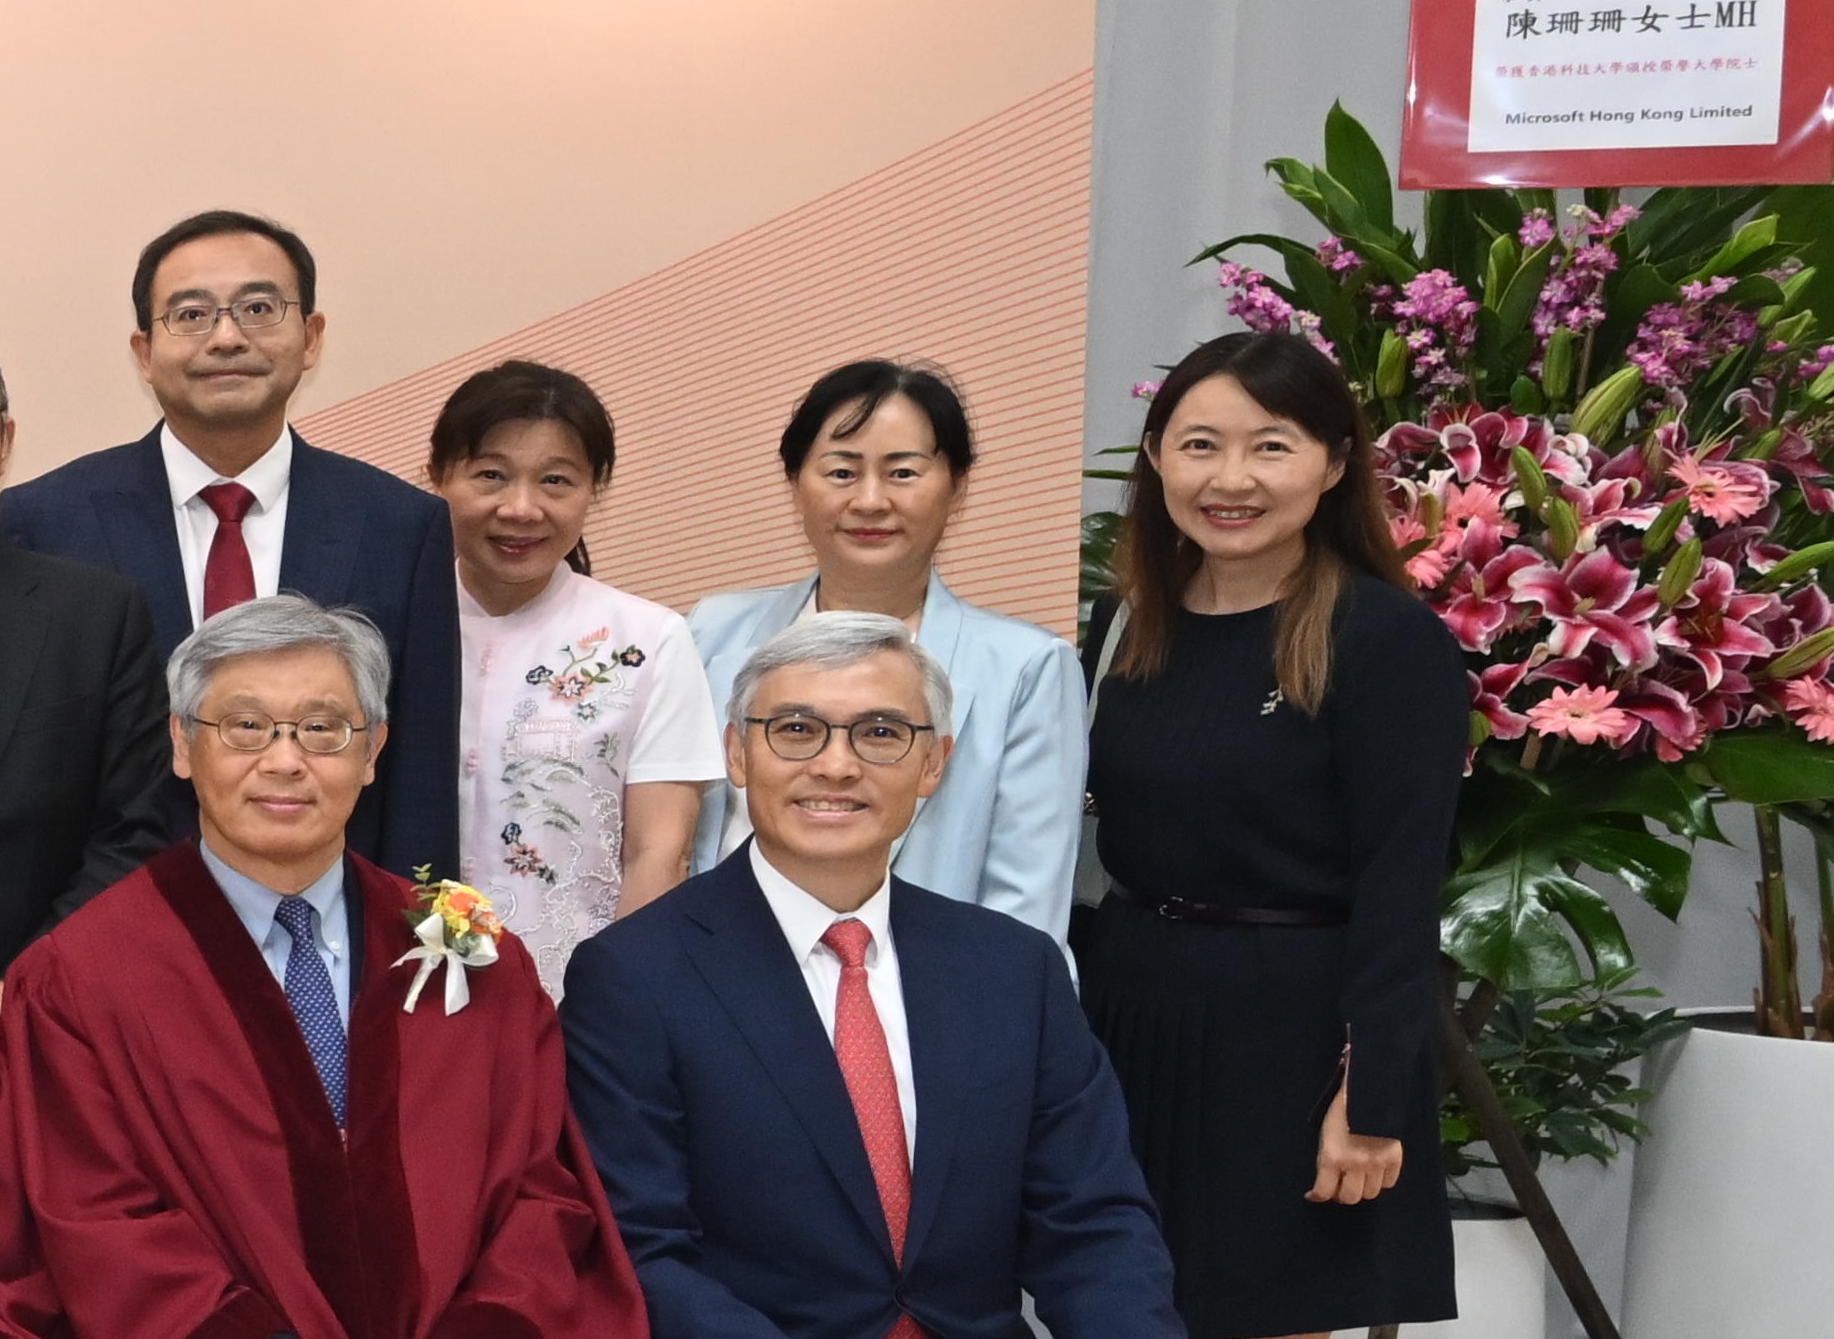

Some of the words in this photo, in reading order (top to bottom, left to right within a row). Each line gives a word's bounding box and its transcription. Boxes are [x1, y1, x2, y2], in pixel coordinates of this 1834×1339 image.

[1505, 0, 1758, 39] 陳珊珊女士MH
[1505, 110, 1584, 125] Microsoft
[1589, 109, 1635, 124] Hong
[1640, 108, 1684, 122] Kong
[1690, 105, 1753, 119] Limited
